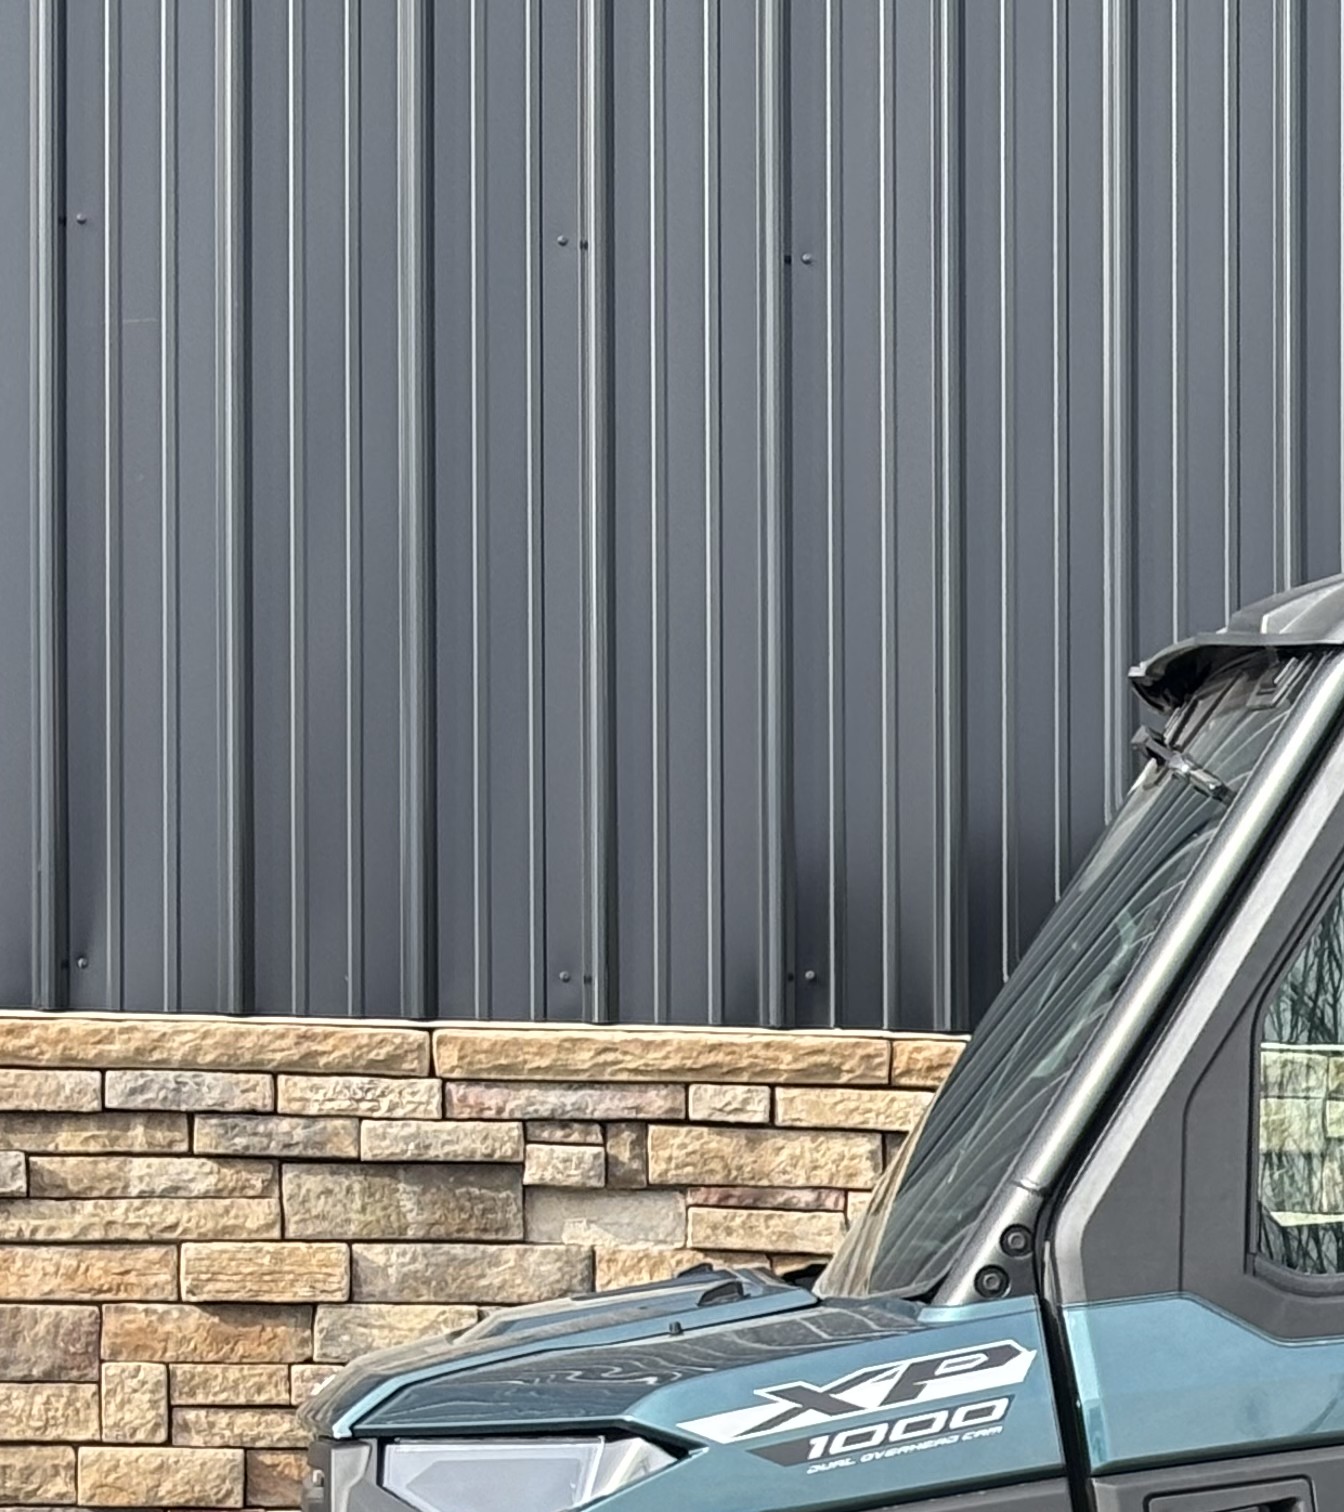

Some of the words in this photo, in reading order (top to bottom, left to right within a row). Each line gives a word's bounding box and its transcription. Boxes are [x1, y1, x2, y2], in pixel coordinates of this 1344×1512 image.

[742, 1340, 1026, 1438] XP
[806, 1457, 857, 1475] DUAL
[860, 1434, 960, 1463] OVERHEAD
[962, 1426, 1003, 1441] CAM
[807, 1398, 1010, 1460] 1000
